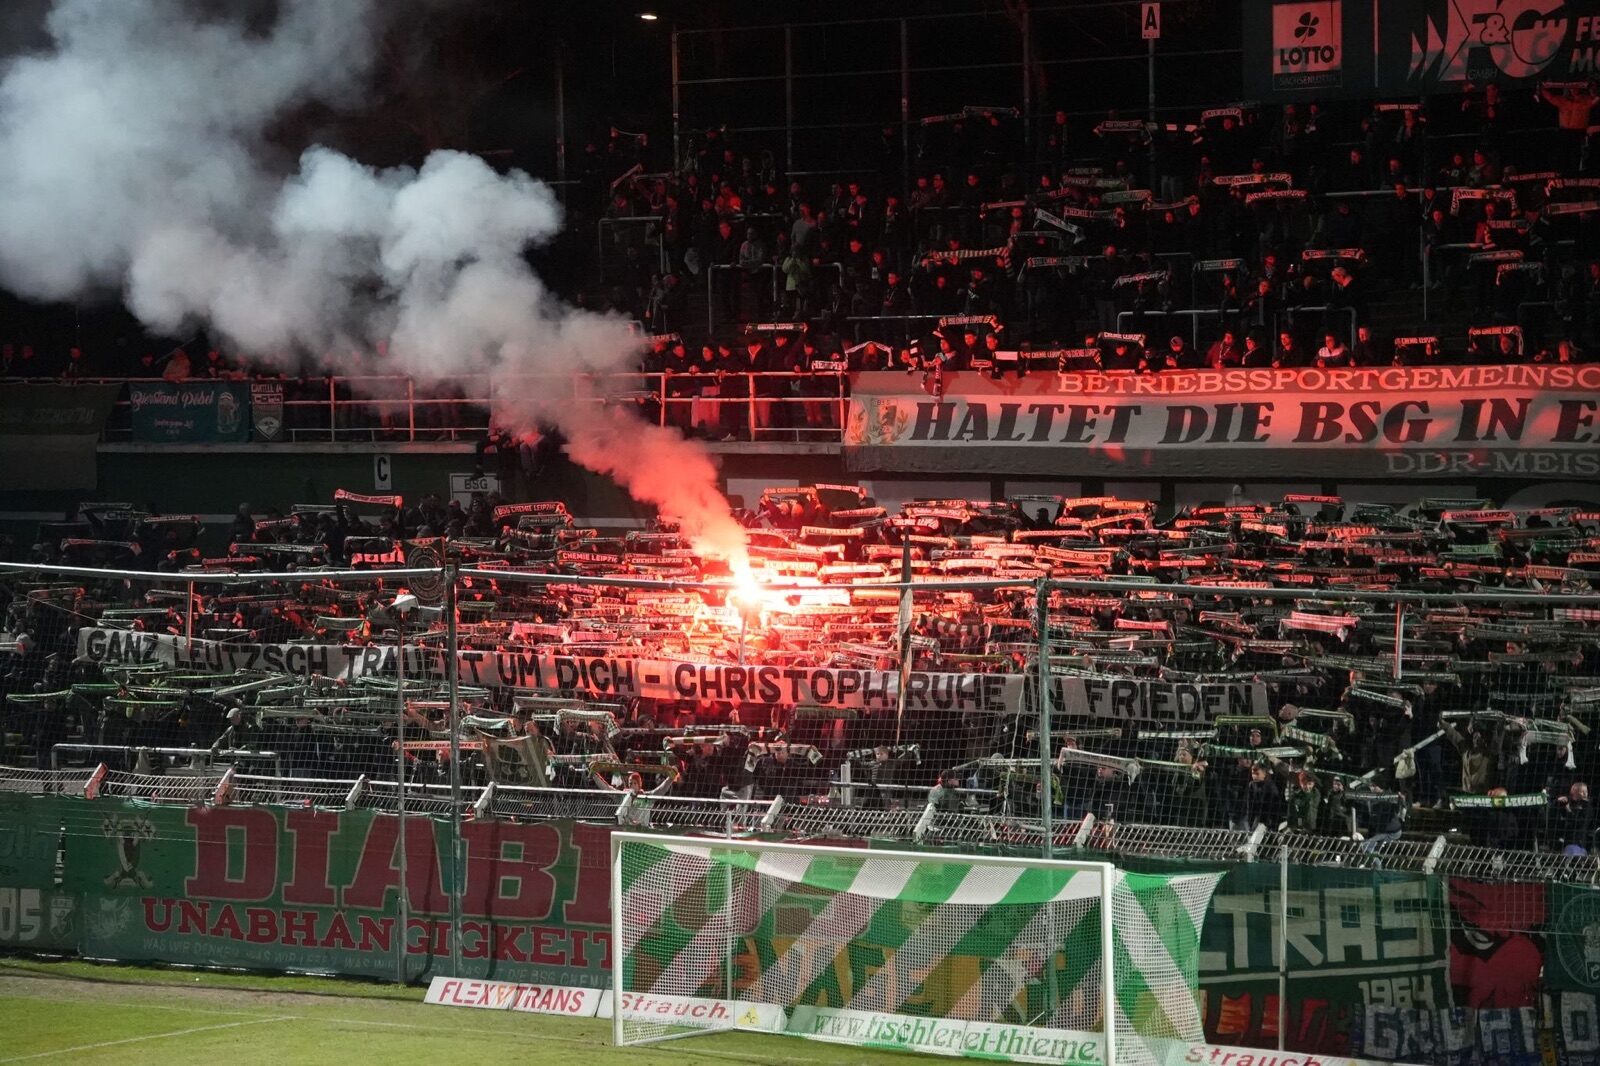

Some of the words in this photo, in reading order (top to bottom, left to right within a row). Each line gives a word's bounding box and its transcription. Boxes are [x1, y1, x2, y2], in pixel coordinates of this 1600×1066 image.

[1144, 4, 1159, 30] A
[1279, 45, 1335, 66] LOTTO
[907, 401, 1141, 443] HALTET
[1157, 402, 1275, 444] DIE
[1291, 399, 1433, 444] BSG
[1453, 398, 1533, 442] IN
[376, 457, 390, 482] C
[464, 479, 488, 490] BSG
[511, 505, 533, 514] CHEMIE
[562, 551, 590, 561] CHEMIE
[591, 553, 618, 563] LEIPZIG
[86, 630, 159, 665] GANZ
[173, 636, 328, 677] LEUTZSCH
[496, 653, 543, 688] UM
[554, 656, 635, 692] DICH
[906, 672, 1006, 711] RUHE
[1023, 676, 1066, 712] IN
[1083, 678, 1253, 721] FRIEDEN
[1453, 797, 1492, 807] CHEMIE
[1505, 795, 1543, 807] LEIPZIG
[438, 980, 497, 1006] FLEX
[513, 985, 585, 1014] TRANS
[1358, 974, 1436, 1010] 1964
